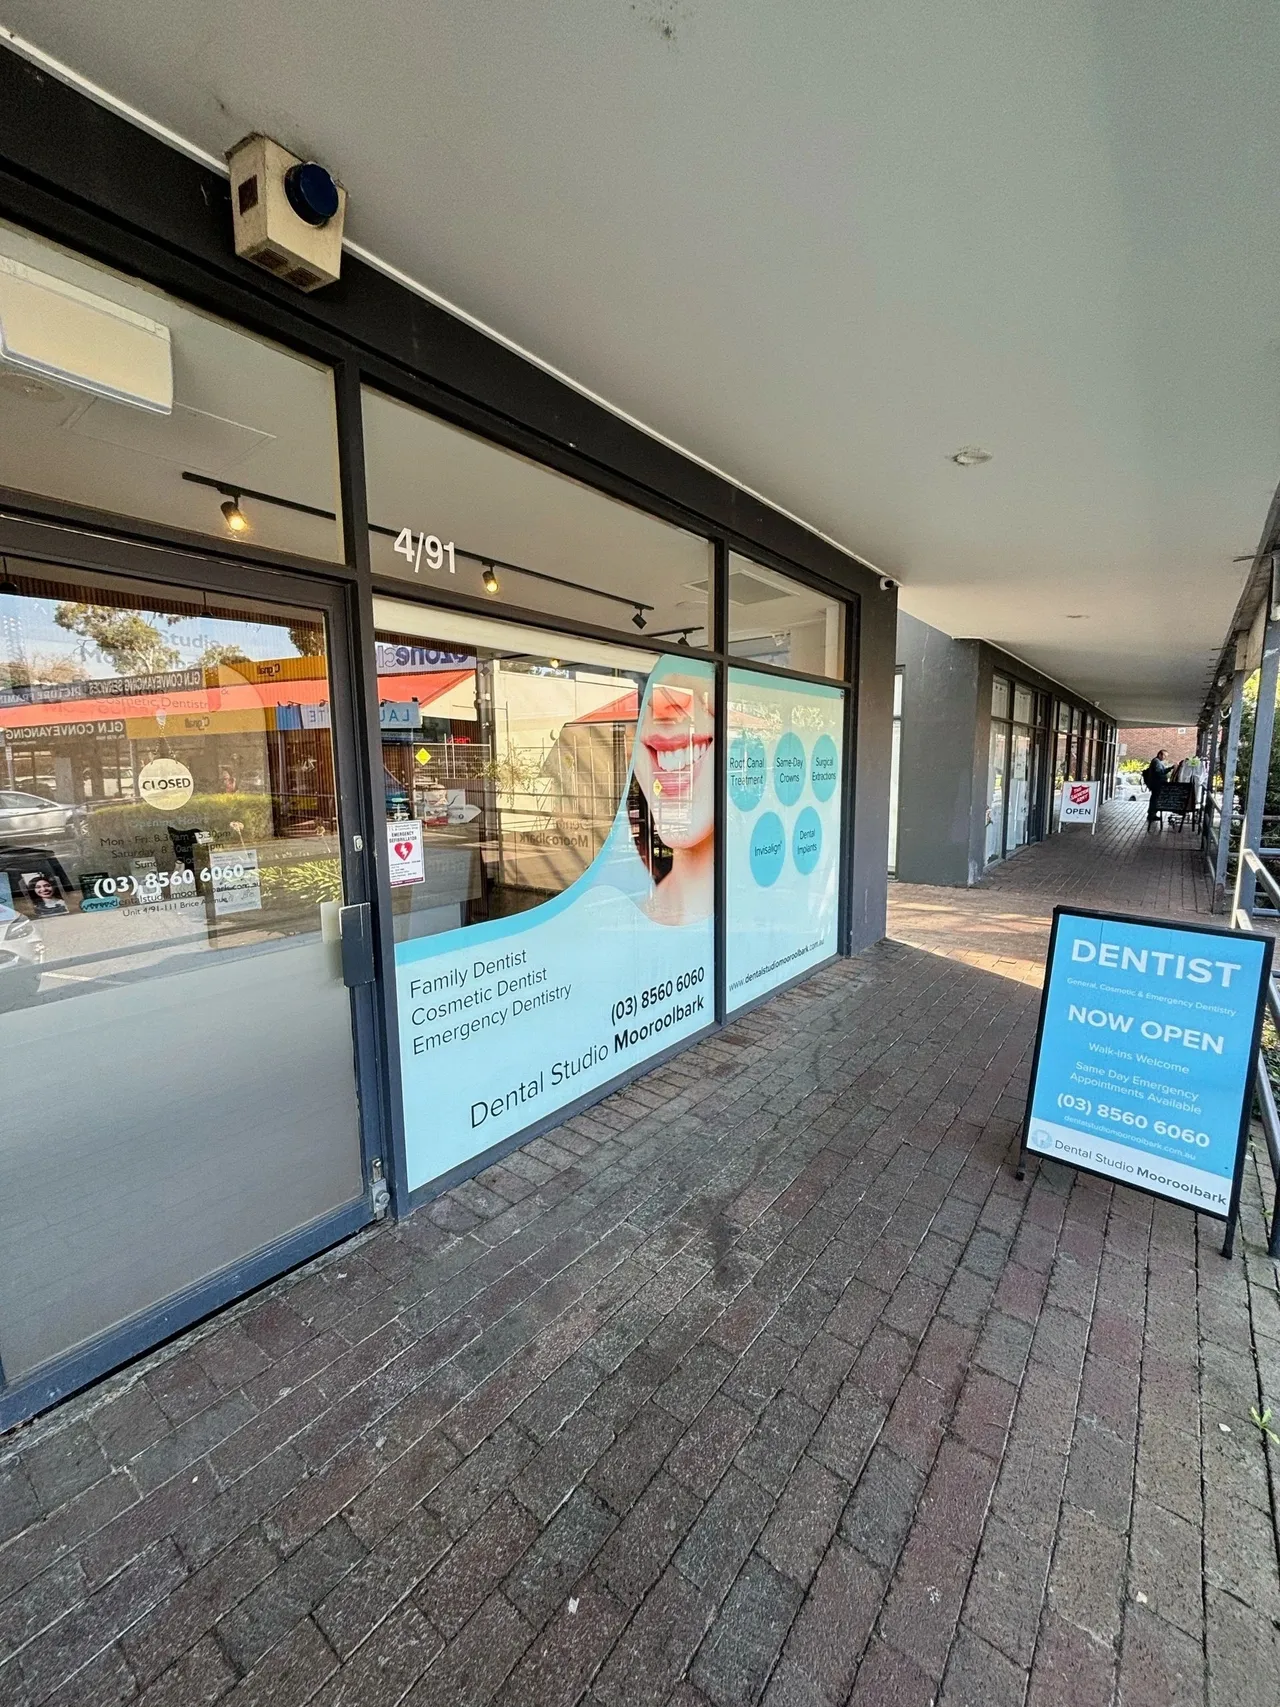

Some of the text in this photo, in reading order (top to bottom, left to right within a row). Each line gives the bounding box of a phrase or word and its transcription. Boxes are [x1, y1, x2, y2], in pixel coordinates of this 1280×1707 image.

[393, 527, 456, 574] 4/91
[730, 774, 764, 786] Treatment
[746, 757, 765, 768] Canal
[776, 757, 804, 769] Same-Day
[779, 773, 800, 783] Crowns
[811, 771, 837, 781] Extractions
[815, 757, 834, 769] Surgical
[142, 777, 192, 791] CLOSED
[1065, 807, 1092, 815] OPEN
[100, 837, 125, 848] Mon
[800, 829, 816, 840] Dental
[93, 875, 139, 899] (03)
[144, 868, 196, 889] 8560
[199, 863, 244, 882] 6060
[122, 908, 141, 917] Unit
[179, 900, 200, 909] Brice
[410, 949, 528, 998] Family Dentist
[1071, 938, 1242, 988] DENTIST
[411, 967, 548, 1026] Cosmetic Dentist
[610, 966, 705, 1026] (03) 8560 6060
[1099, 983, 1136, 998] Cosmetic
[1145, 992, 1194, 1010] Emergency
[1195, 1001, 1238, 1018] Dentistry
[413, 983, 572, 1056] Emergency Dentistry
[1067, 1004, 1225, 1055] NOW OPEN
[470, 994, 705, 1129] Dental Studio Mooroolbark
[1135, 1052, 1191, 1075] Welcome
[1069, 1072, 1203, 1116] Appointments Available
[1075, 1061, 1200, 1102] Same Day Emergency
[1056, 1092, 1211, 1149] (03) 8560 6060
[1054, 1139, 1228, 1206] Dental Studio Mooroolbark
